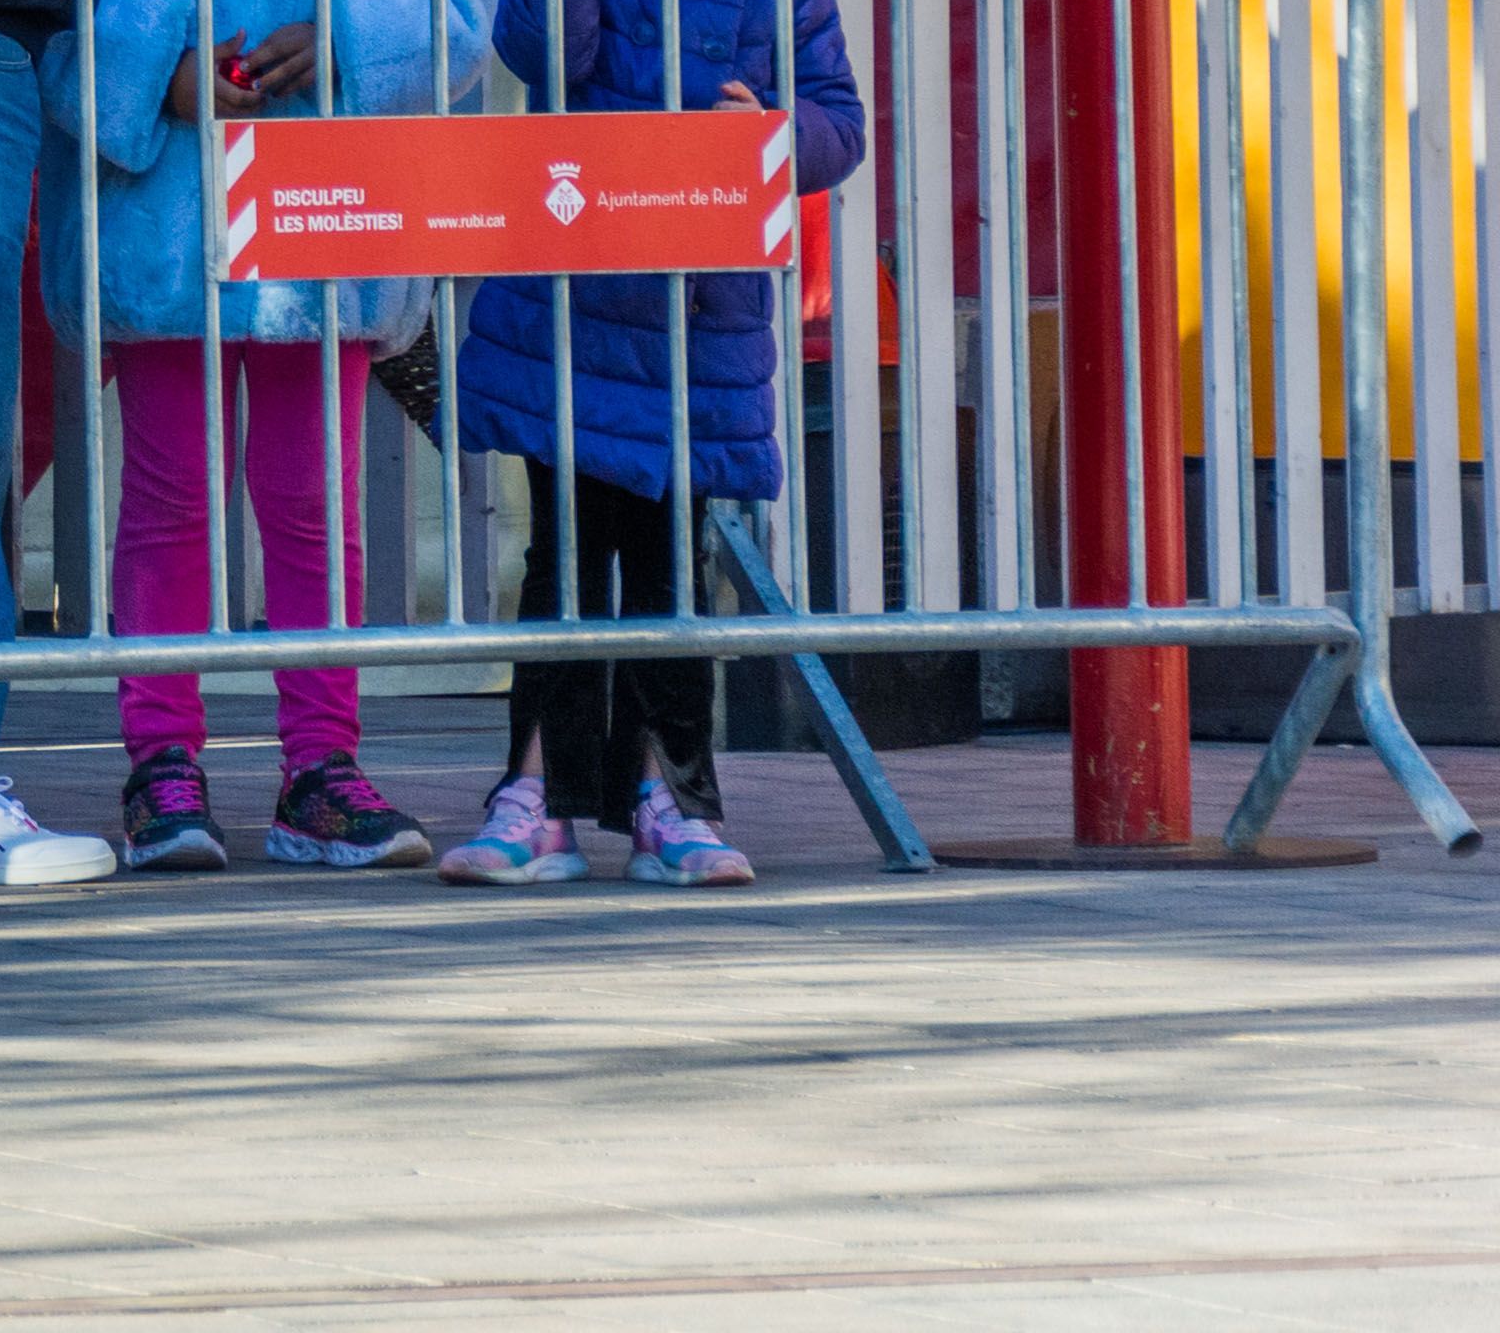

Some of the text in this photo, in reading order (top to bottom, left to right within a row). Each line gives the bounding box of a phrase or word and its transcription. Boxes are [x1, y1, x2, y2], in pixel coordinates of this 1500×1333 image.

[273, 188, 365, 207] DISCULPEU
[597, 187, 748, 210] Ajuntament de Rubí
[274, 212, 403, 233] LES MOLÈSTIES!
[427, 214, 506, 229] www.rubi.cat
